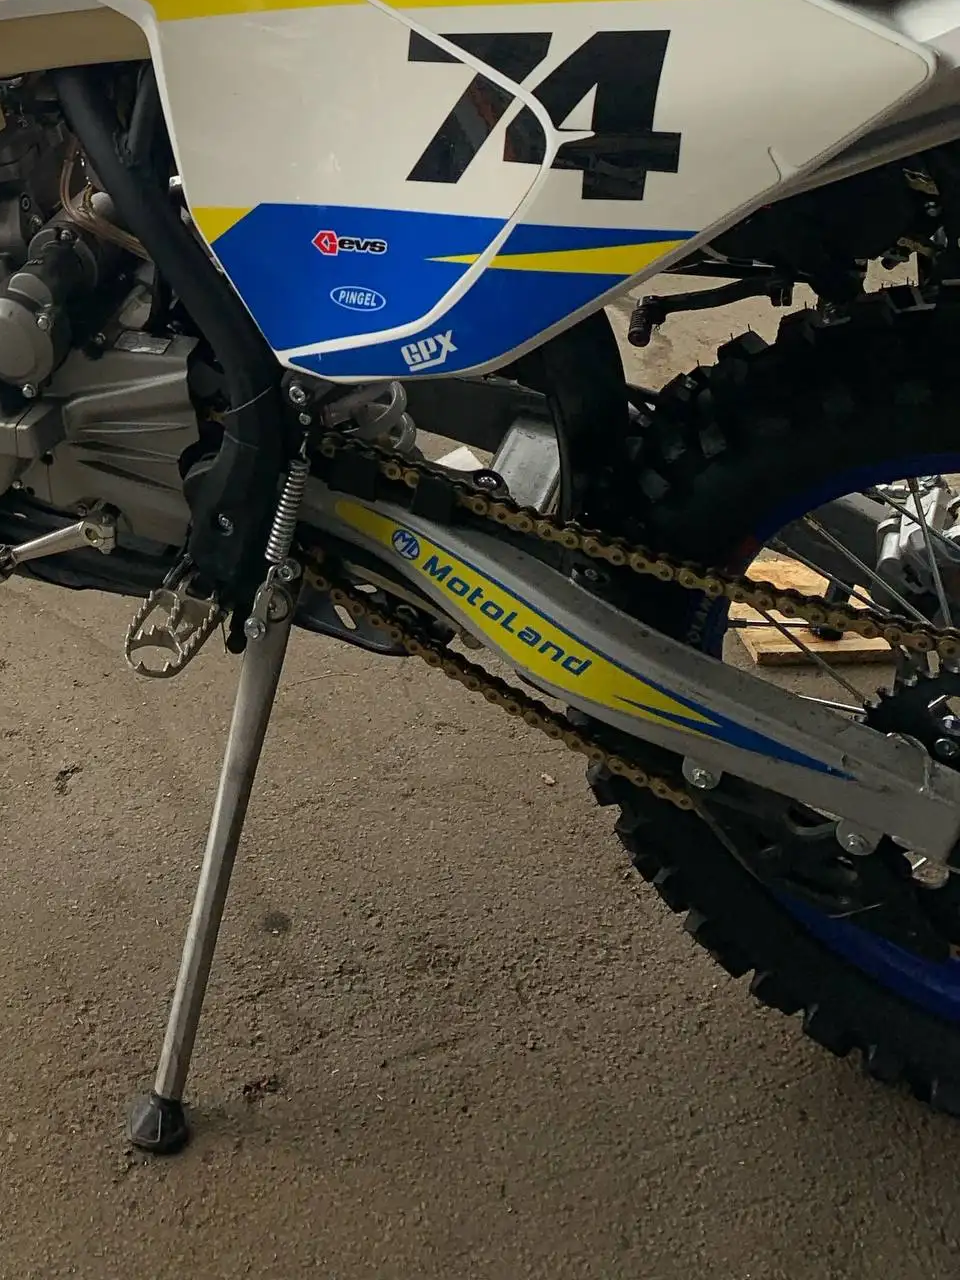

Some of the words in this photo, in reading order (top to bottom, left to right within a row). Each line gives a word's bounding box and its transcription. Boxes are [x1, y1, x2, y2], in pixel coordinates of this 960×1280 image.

[406, 29, 682, 200] 74
[339, 290, 377, 307] PINGEL
[401, 329, 458, 372] GPX
[422, 555, 593, 677] MotoLand
